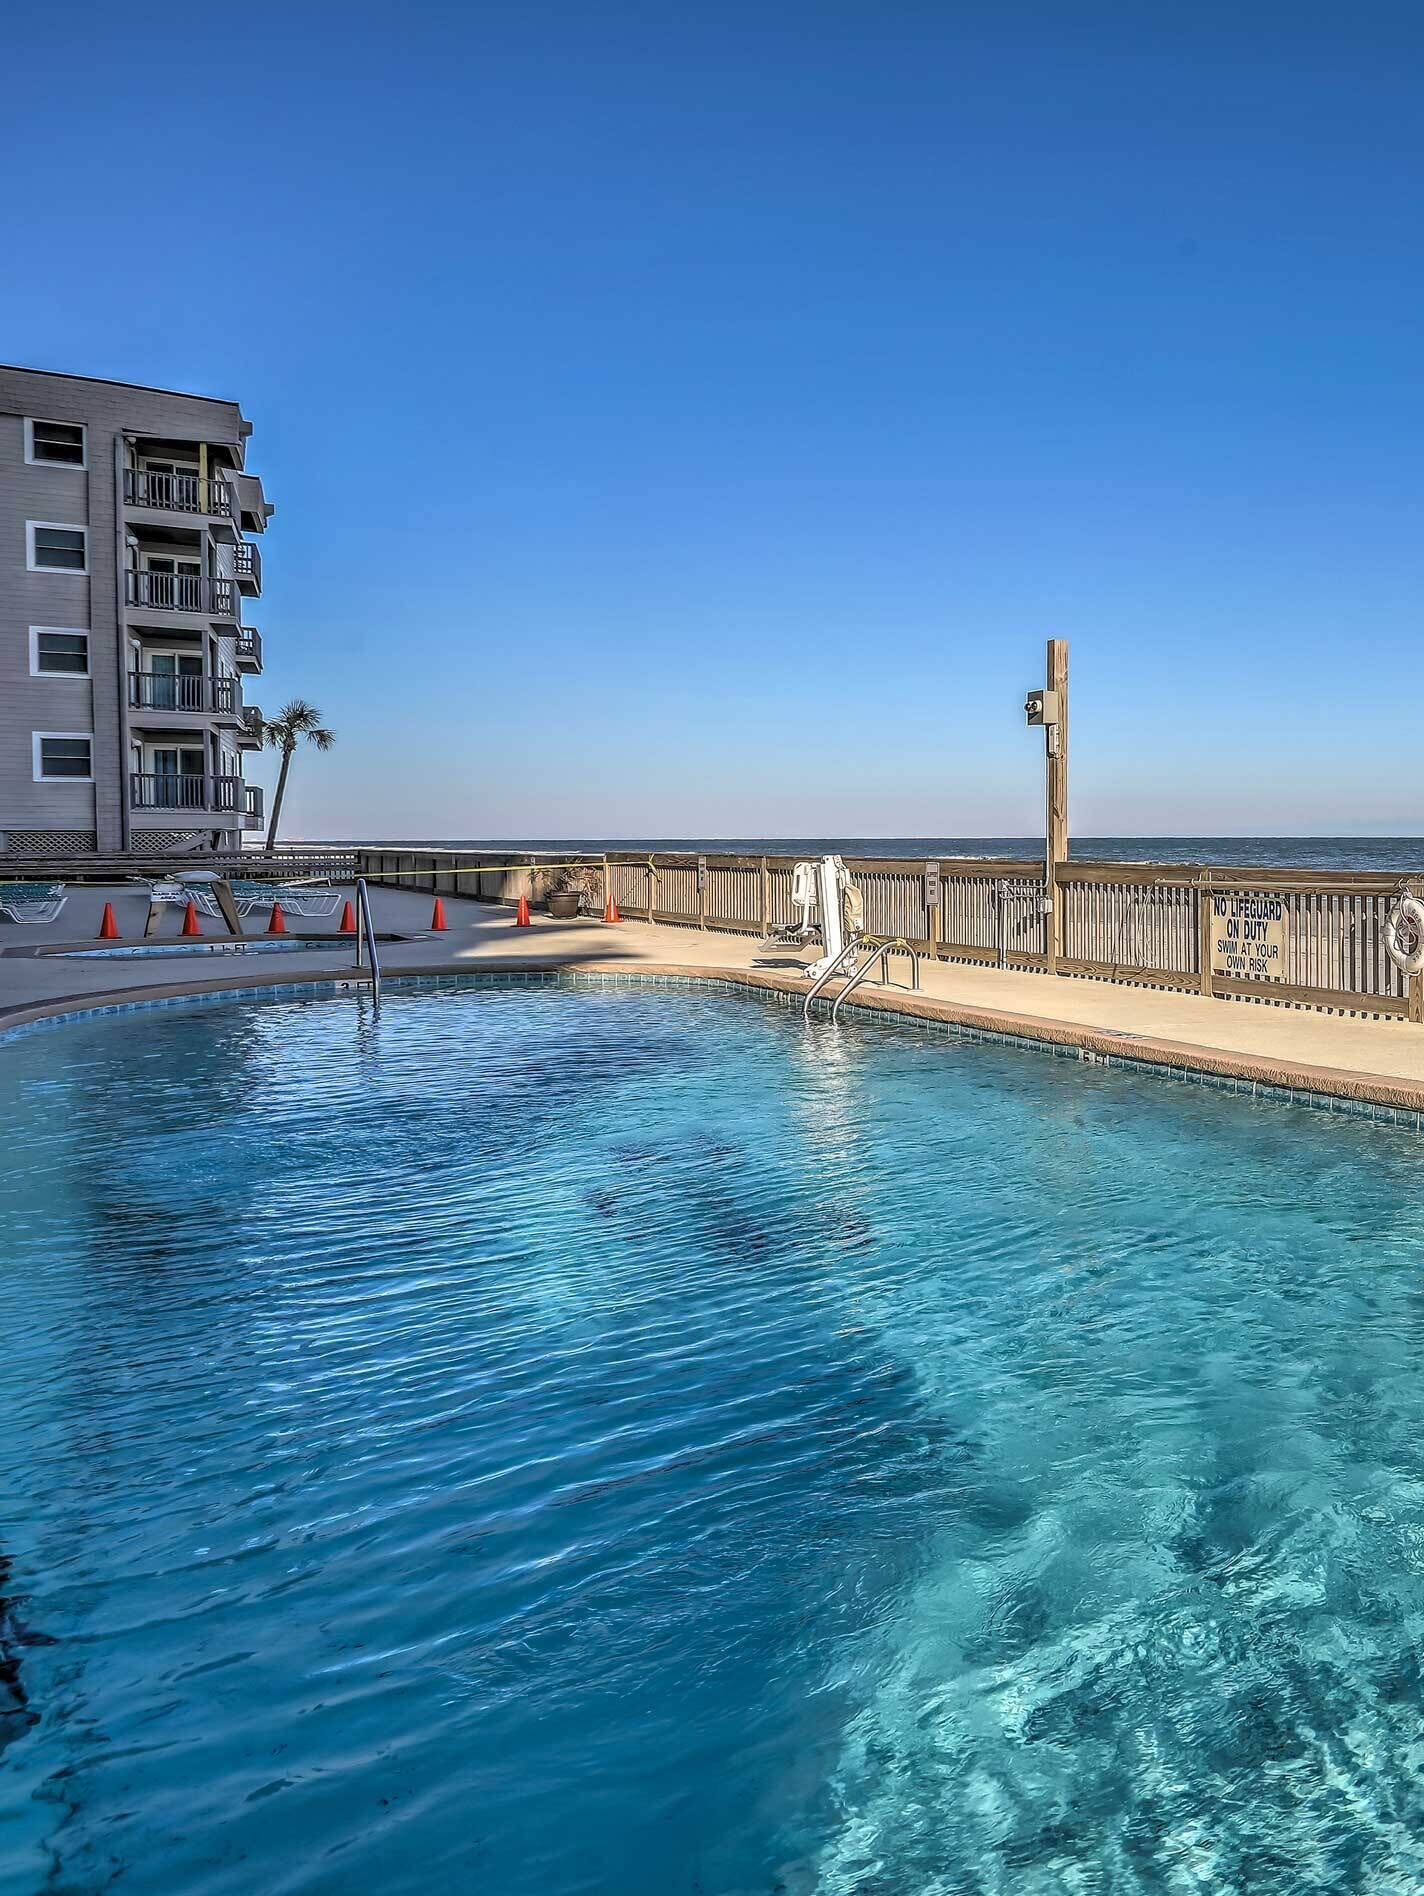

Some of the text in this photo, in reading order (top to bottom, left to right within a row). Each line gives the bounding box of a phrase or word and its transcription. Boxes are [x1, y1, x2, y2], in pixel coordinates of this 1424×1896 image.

[1214, 897, 1281, 920] NO LIFEGUARD
[1227, 919, 1268, 941] ON DUTY
[1217, 940, 1278, 959] SWIM AT YOUR
[1227, 955, 1267, 972] OWN RISK
